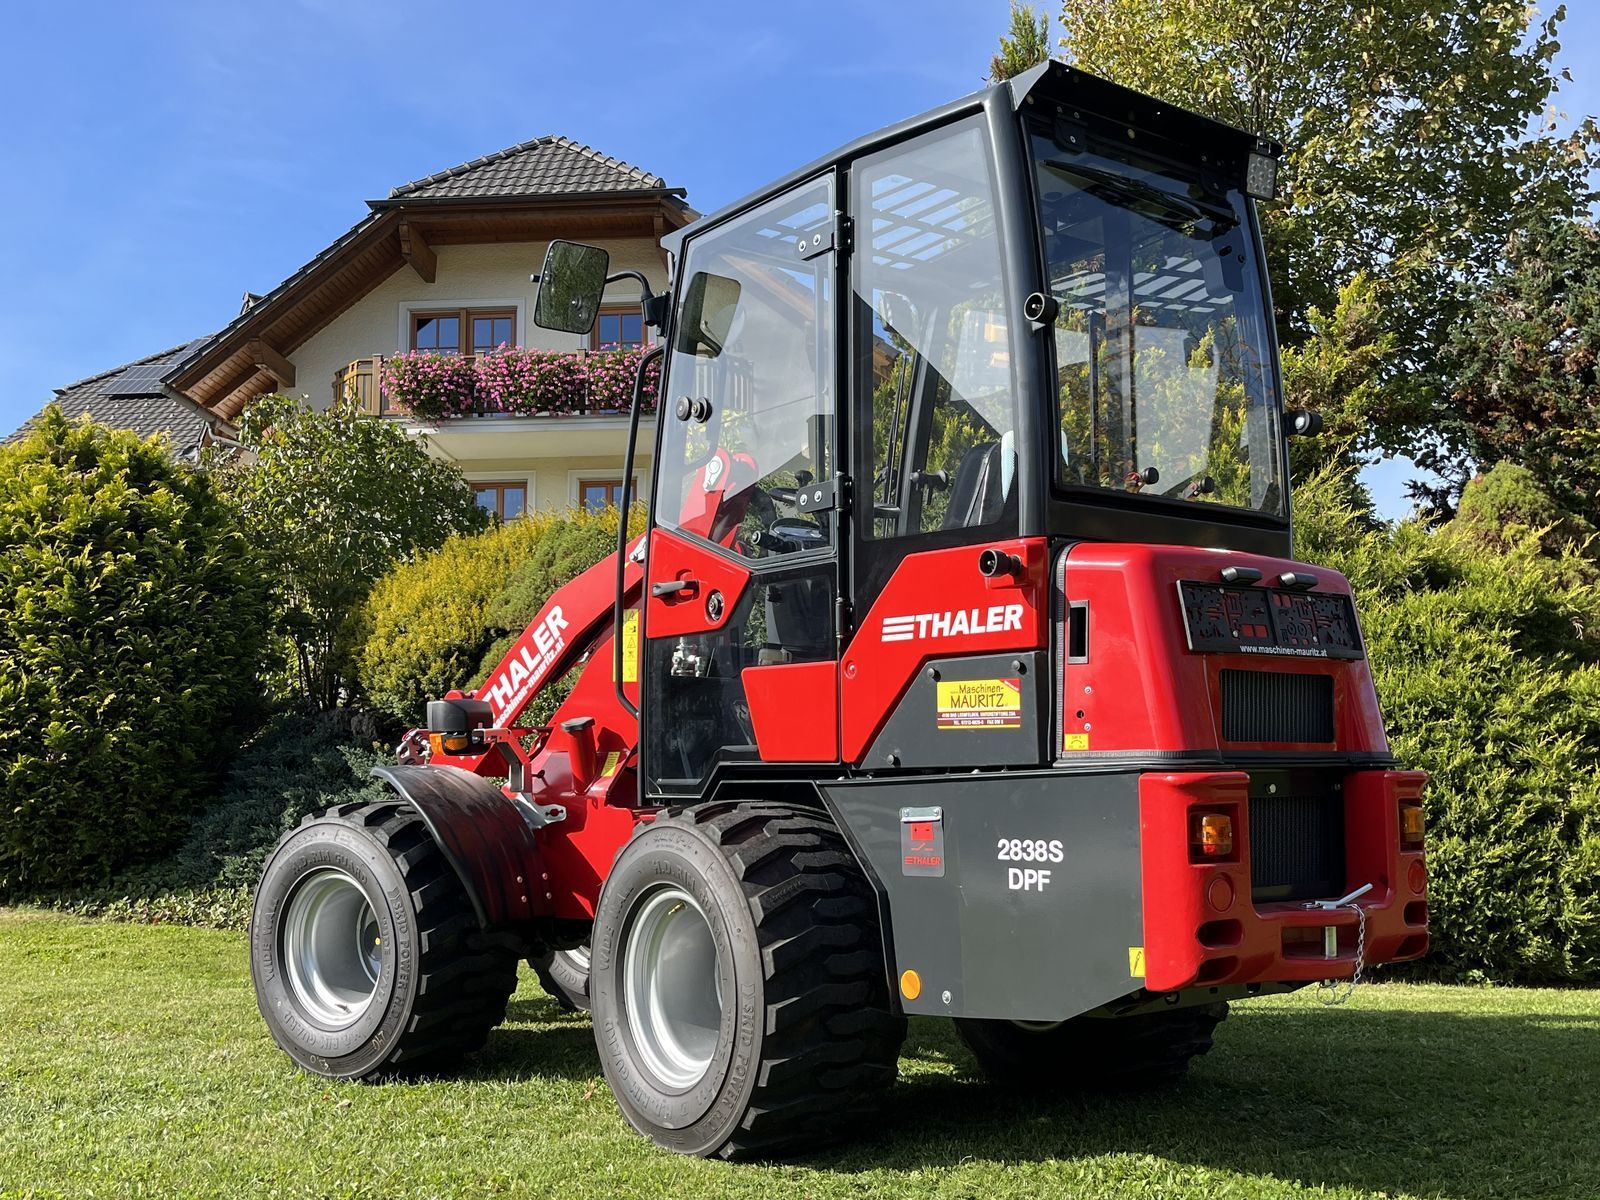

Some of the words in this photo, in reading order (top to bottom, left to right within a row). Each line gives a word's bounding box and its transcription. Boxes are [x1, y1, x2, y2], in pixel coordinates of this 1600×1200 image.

[914, 604, 1024, 639] THALER
[1239, 644, 1328, 657] www.maschinen-mauritz.at
[959, 683, 1004, 694] Maschinen-
[950, 693, 1004, 709] MAURITZ
[997, 838, 1064, 863] 2838S
[1008, 868, 1051, 892] DPF
[395, 940, 411, 991] POWER
[722, 1054, 750, 1109] POWER
